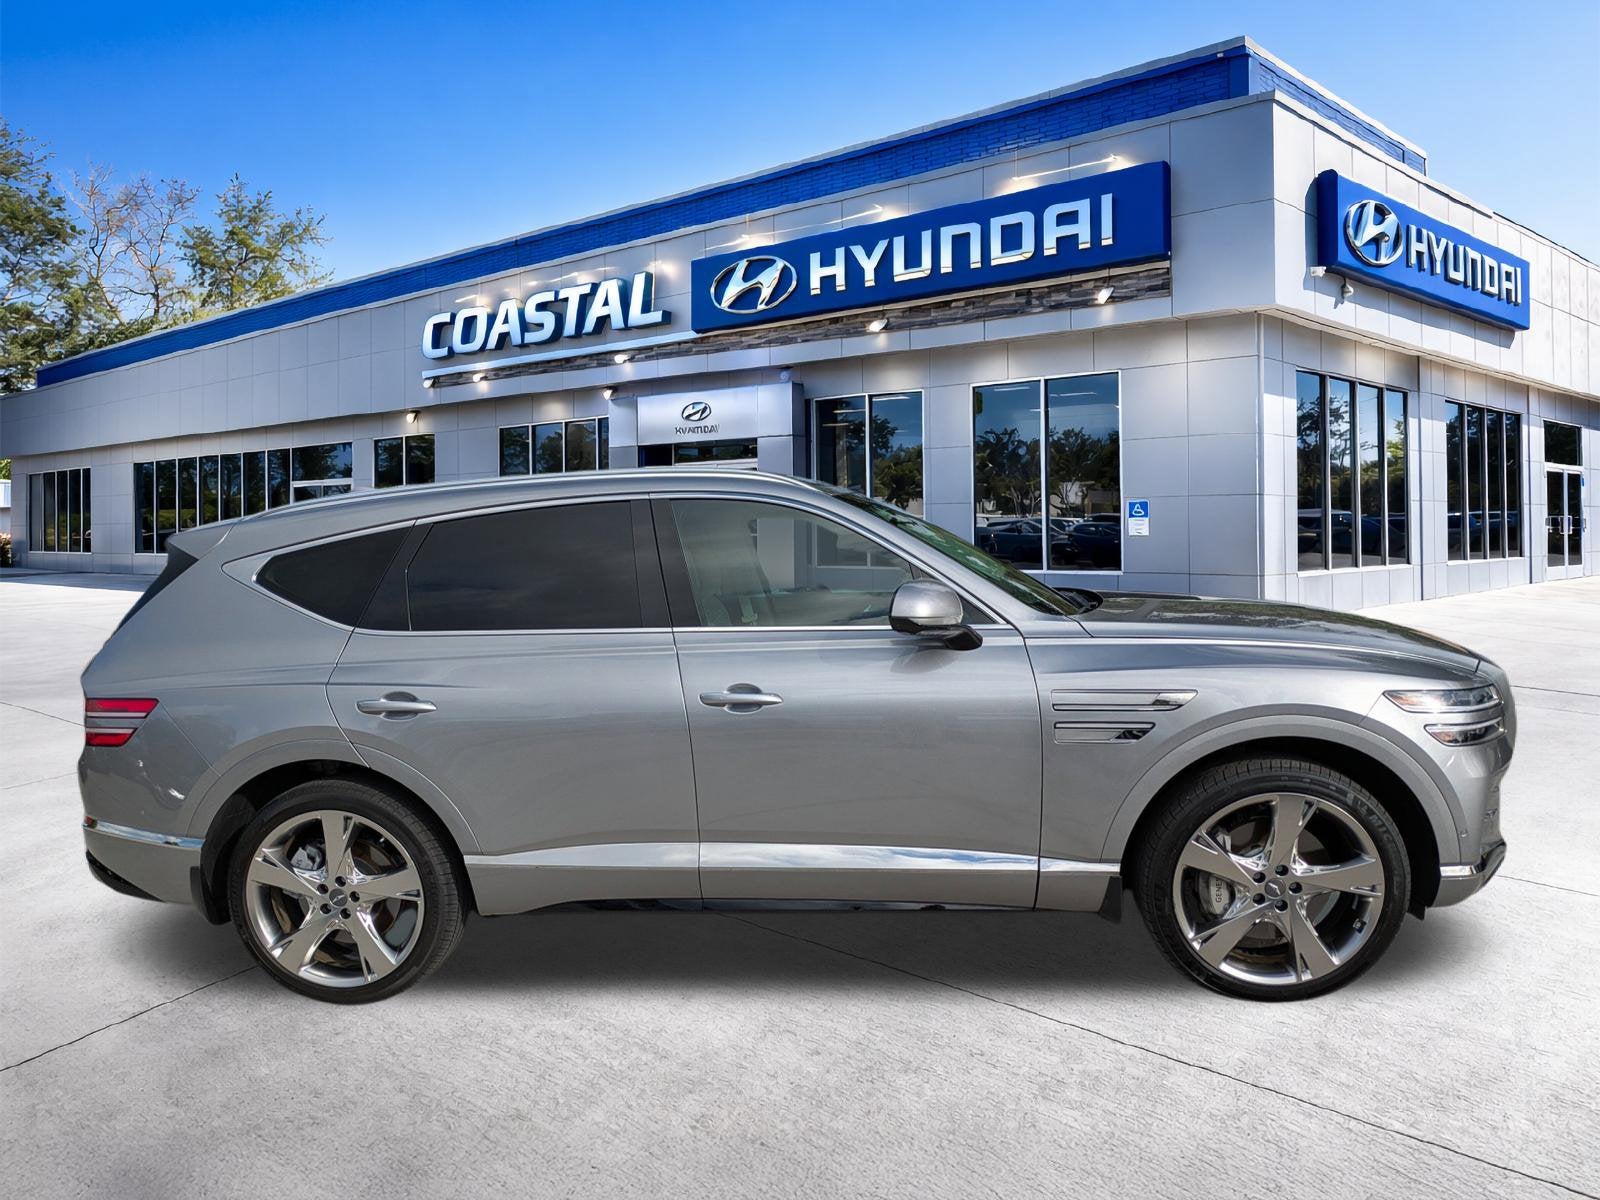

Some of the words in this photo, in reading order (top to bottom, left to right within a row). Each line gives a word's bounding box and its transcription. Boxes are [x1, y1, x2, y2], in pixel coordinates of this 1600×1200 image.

[809, 193, 1114, 295] HYUNDAI
[1408, 225, 1522, 305] HYUNDAI
[422, 272, 668, 360] COASTAL
